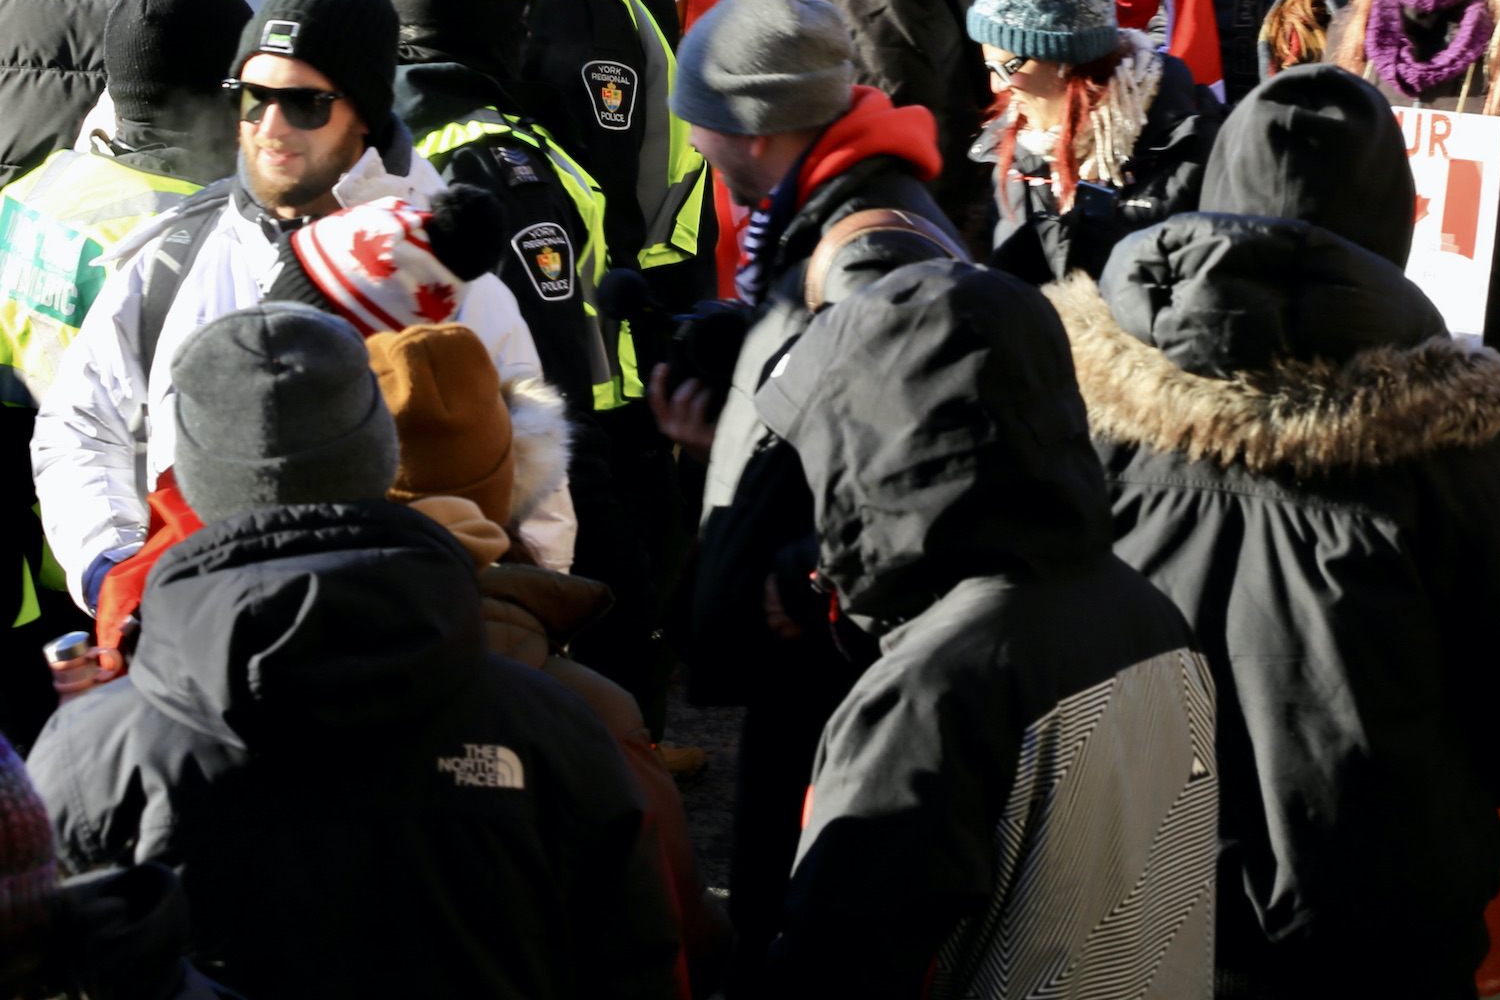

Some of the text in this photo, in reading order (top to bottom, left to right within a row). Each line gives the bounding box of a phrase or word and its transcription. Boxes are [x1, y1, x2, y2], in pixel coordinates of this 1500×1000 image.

[597, 65, 622, 76] YORK
[591, 72, 631, 86] REGIONAL
[600, 111, 626, 123] POLICE
[529, 226, 558, 240] YORK
[522, 236, 567, 251] REGIONAL
[541, 278, 570, 293] POLICE
[463, 743, 498, 759] THE
[437, 757, 497, 773] NORTH
[455, 772, 498, 788] FACE
